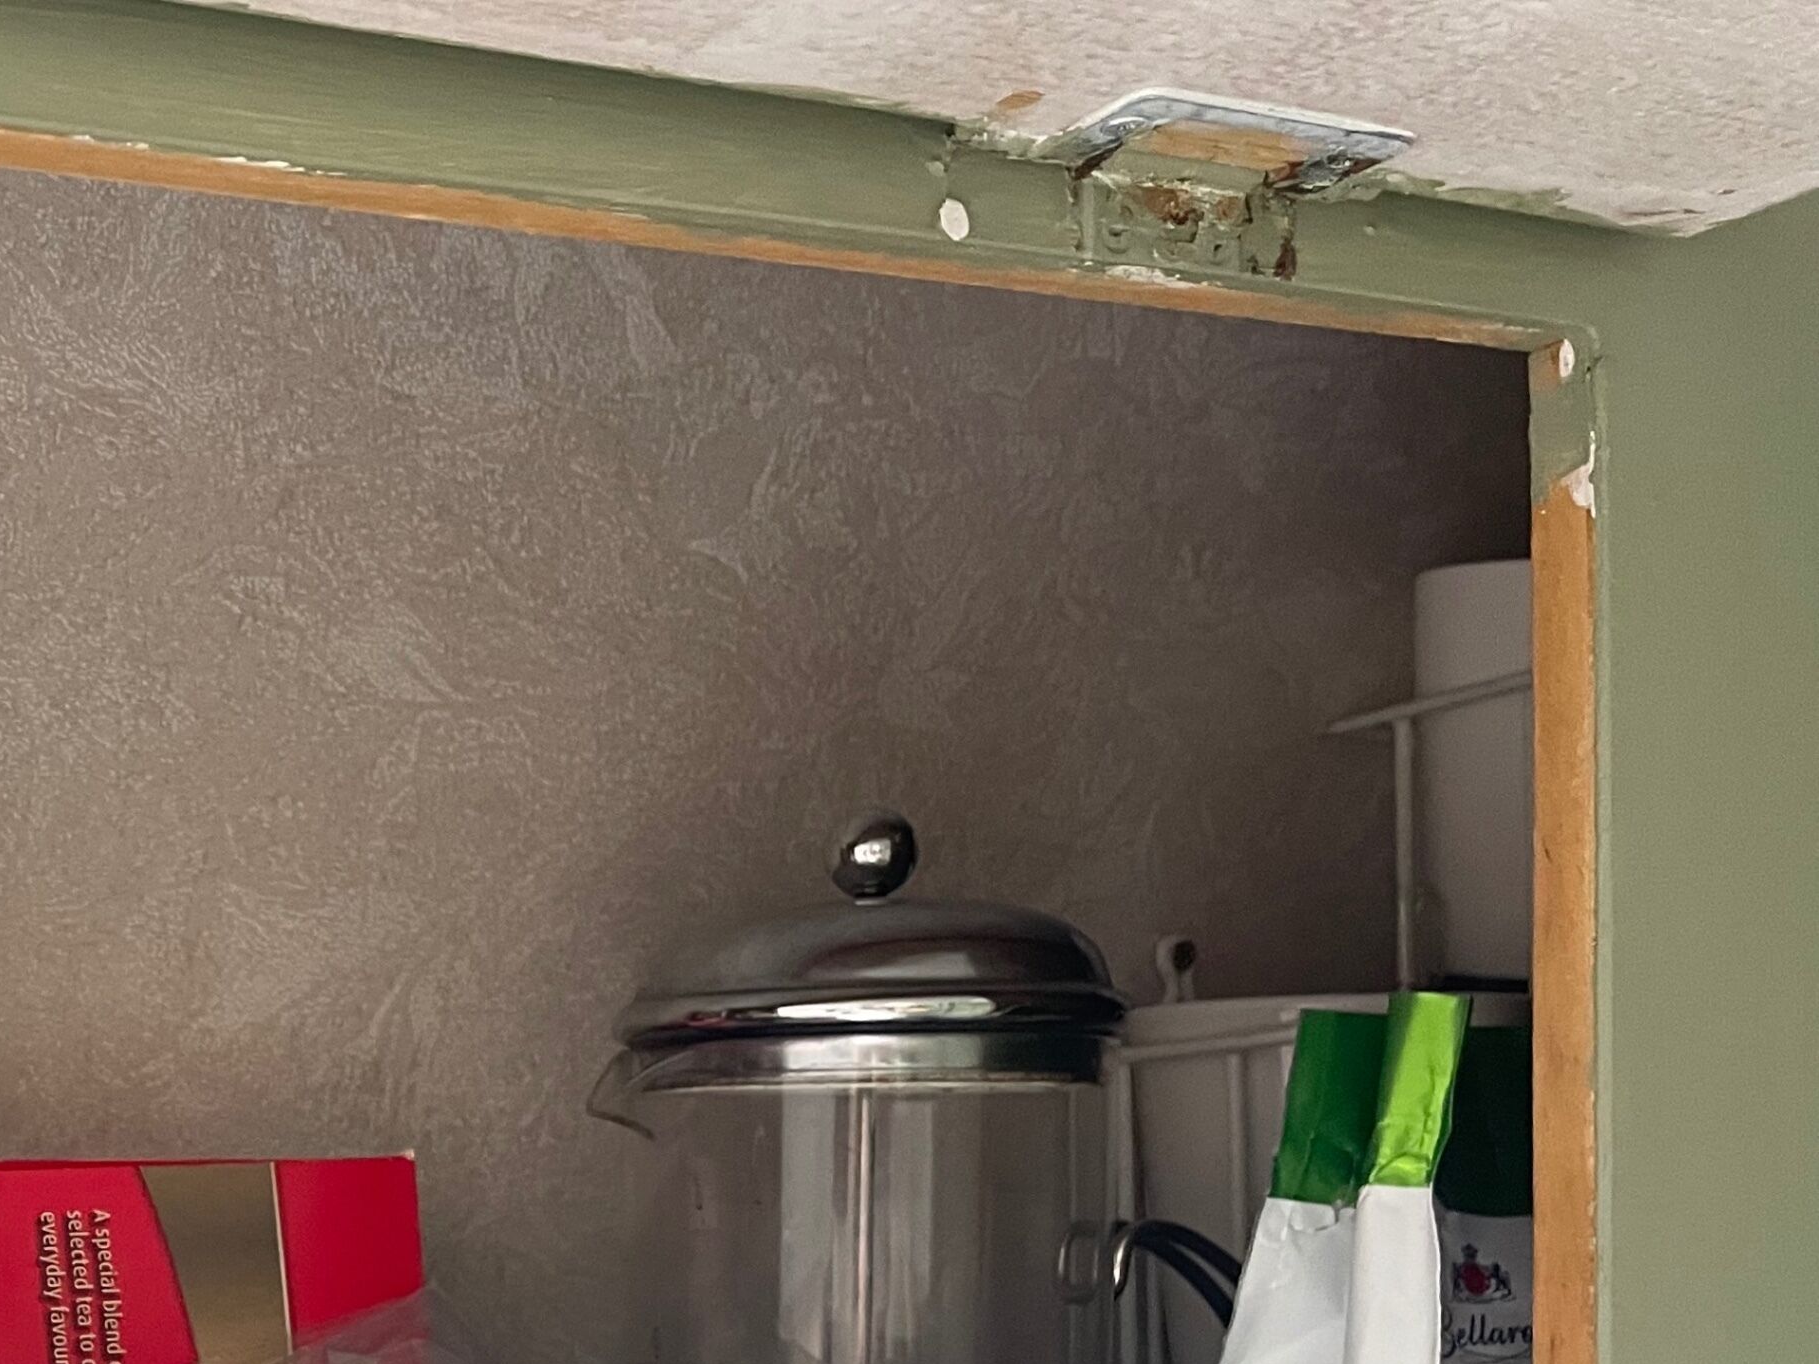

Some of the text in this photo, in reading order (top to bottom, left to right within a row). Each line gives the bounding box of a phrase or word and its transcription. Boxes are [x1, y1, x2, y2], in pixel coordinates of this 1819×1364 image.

[92, 1209, 112, 1223] A
[39, 1210, 67, 1299] everyday
[66, 1209, 94, 1289] selected
[92, 1228, 121, 1294] special
[75, 1297, 97, 1326] tea
[101, 1300, 127, 1354] blend
[78, 1333, 97, 1352] to
